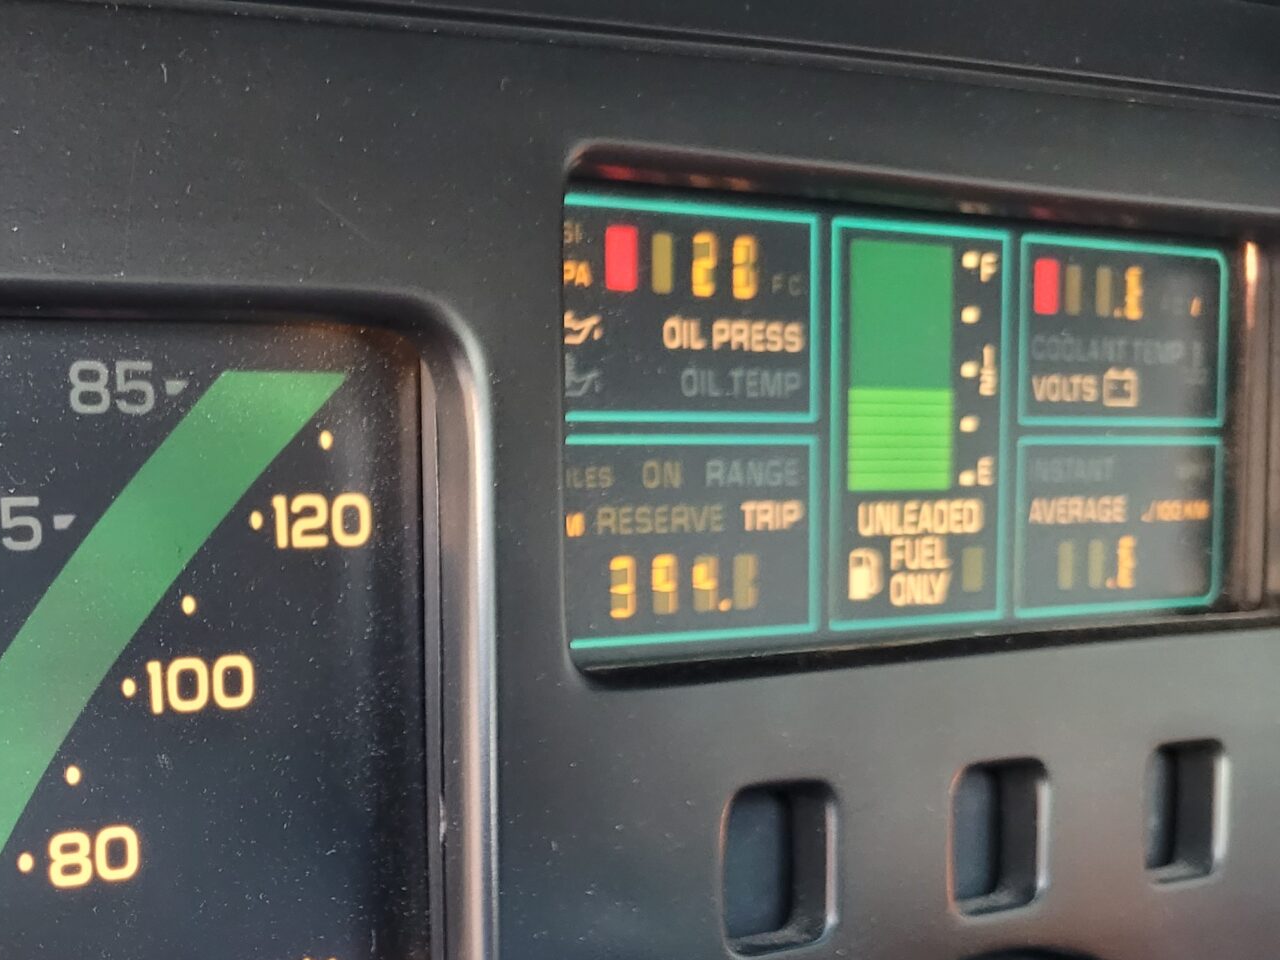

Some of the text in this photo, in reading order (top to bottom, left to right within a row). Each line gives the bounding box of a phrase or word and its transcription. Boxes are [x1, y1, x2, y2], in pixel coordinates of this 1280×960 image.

[662, 315, 805, 353] OIL PRESS
[68, 361, 155, 415] 85
[680, 366, 803, 398] OIL TEMP
[1031, 372, 1098, 402] VOLTS
[642, 457, 801, 489] ON RANGE
[977, 455, 995, 487] E
[273, 493, 372, 550] 120
[595, 500, 805, 536] RESERVE TRIP
[857, 499, 984, 537] UNLEADED
[1028, 494, 1128, 525] AVERAGE
[890, 535, 952, 570] FUEL
[889, 571, 952, 607] ONLY
[146, 655, 255, 714] 100
[47, 826, 140, 889] 80
